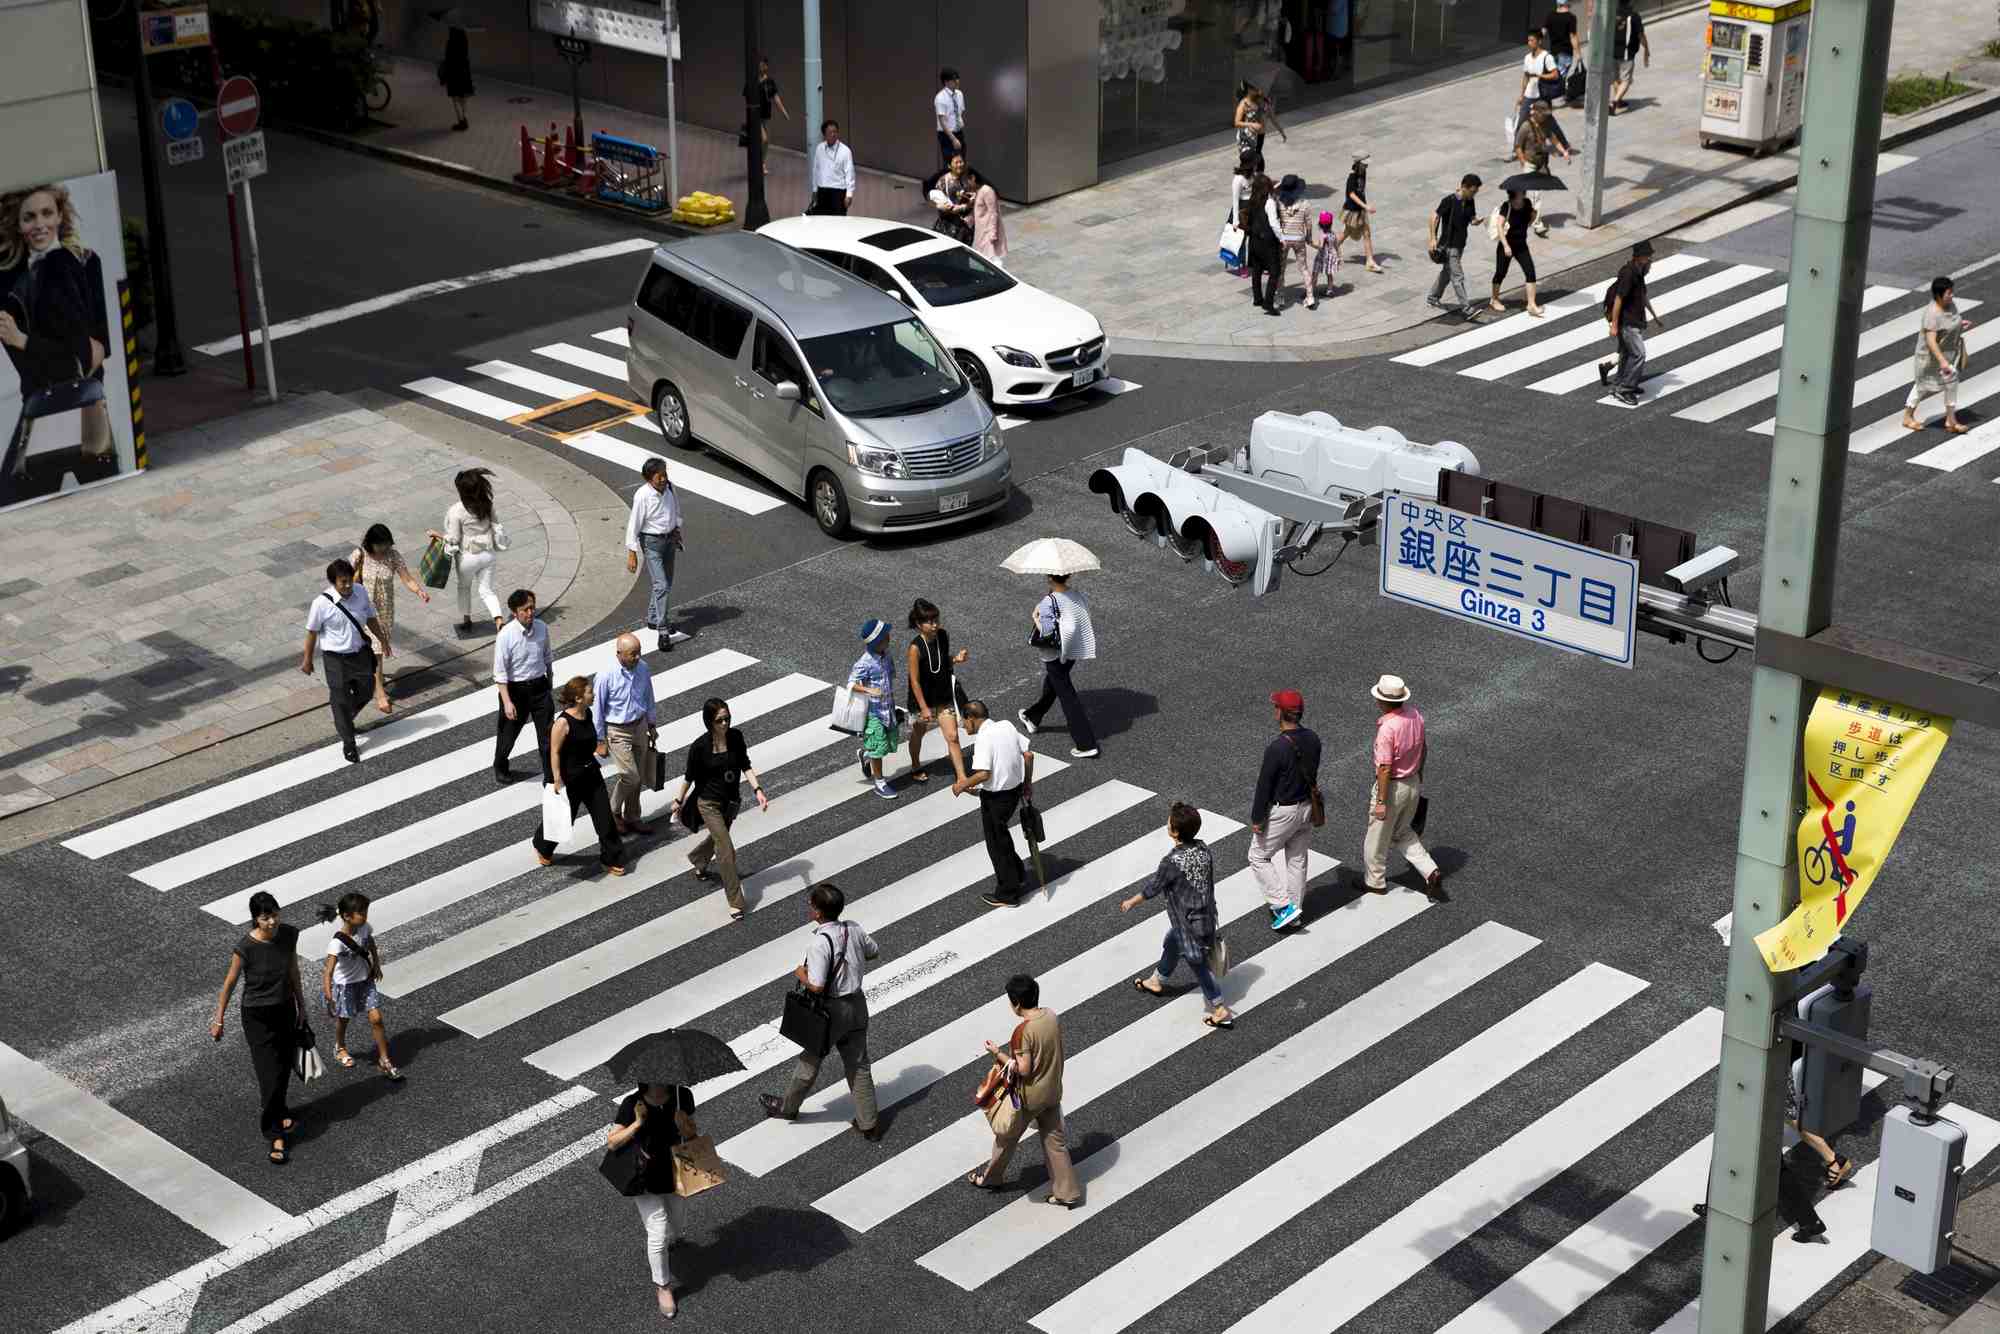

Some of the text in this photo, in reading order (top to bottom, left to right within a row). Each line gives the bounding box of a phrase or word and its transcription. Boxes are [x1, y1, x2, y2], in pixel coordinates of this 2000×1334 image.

[1401, 501, 1467, 538] 中央区
[1398, 526, 1616, 625] 銀座三丁目
[1460, 588, 1545, 632] Ginza 3
[1847, 721, 1904, 745] 歩道は
[1829, 761, 1891, 786] 区間す
